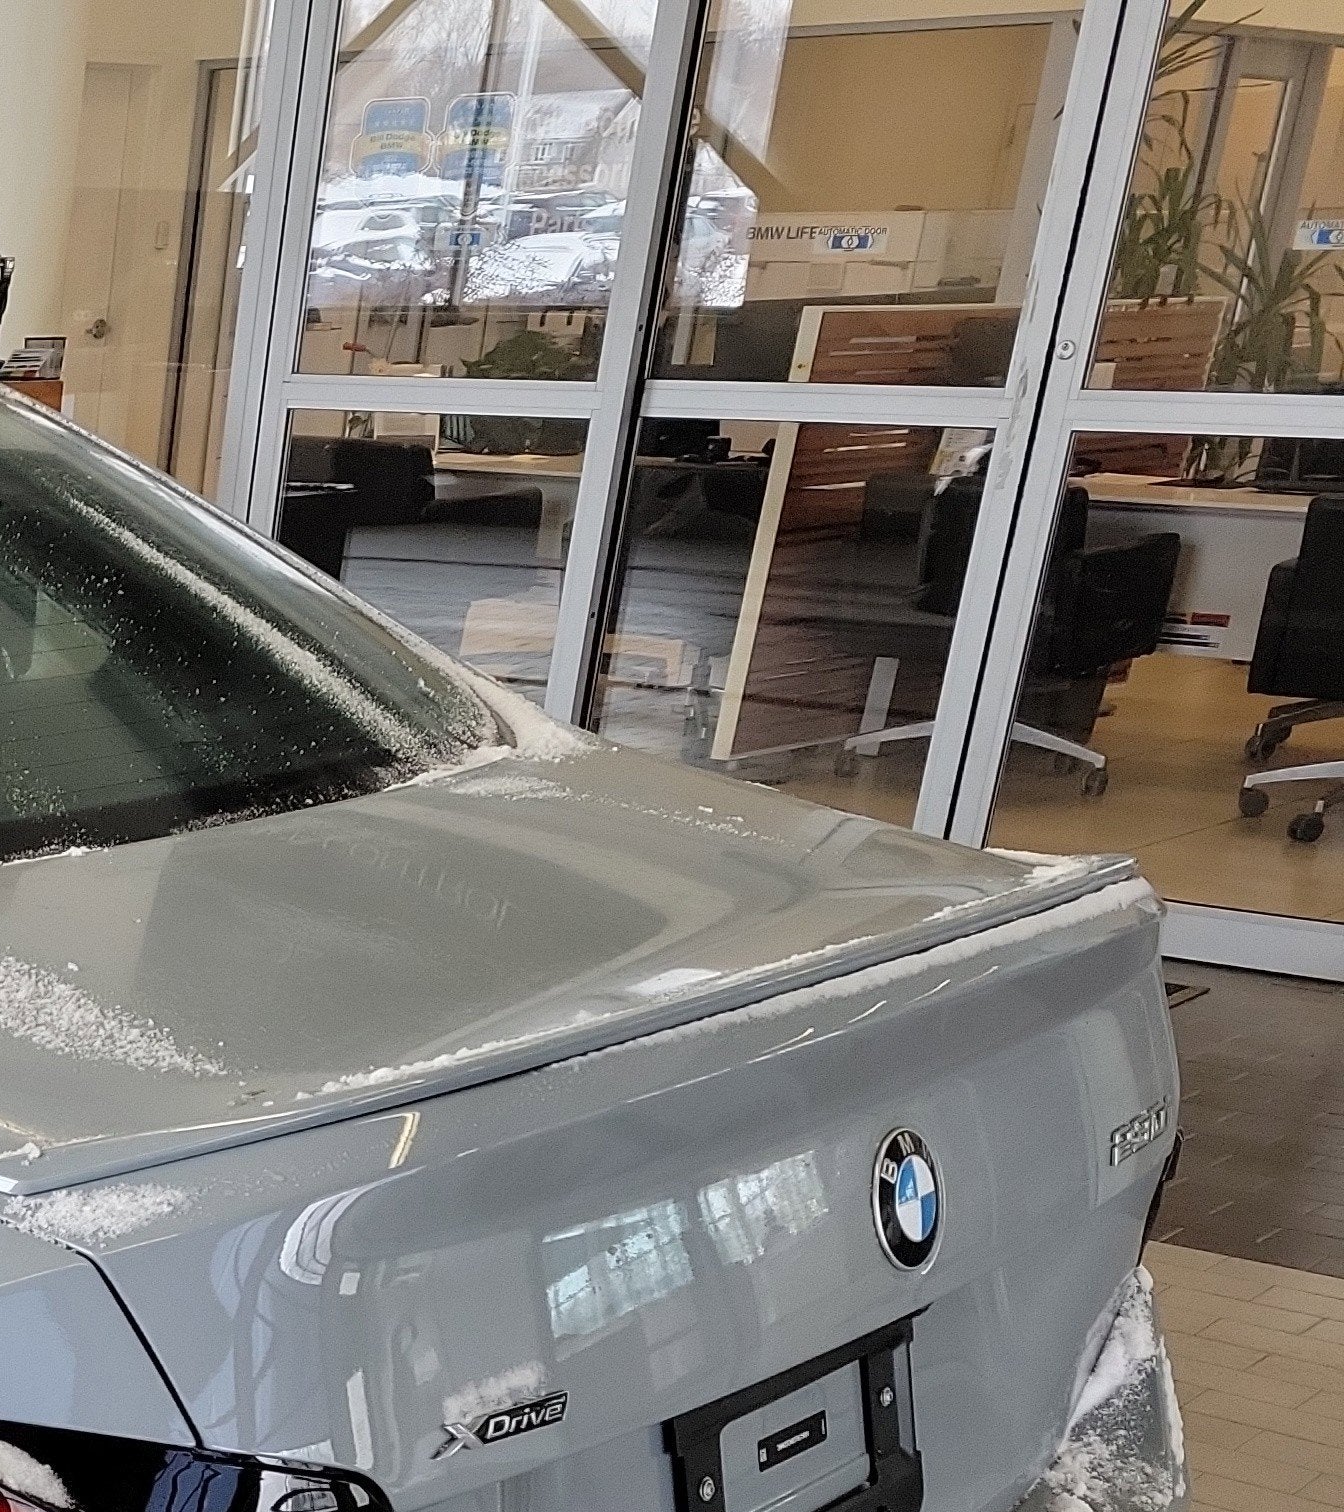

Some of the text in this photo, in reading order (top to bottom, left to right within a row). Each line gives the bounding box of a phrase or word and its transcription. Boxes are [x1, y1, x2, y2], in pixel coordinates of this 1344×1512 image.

[385, 133, 415, 142] Dodge
[746, 226, 784, 240] BMW
[818, 226, 888, 236] AUTOMATIC DOOR
[880, 1132, 934, 1184] BMW
